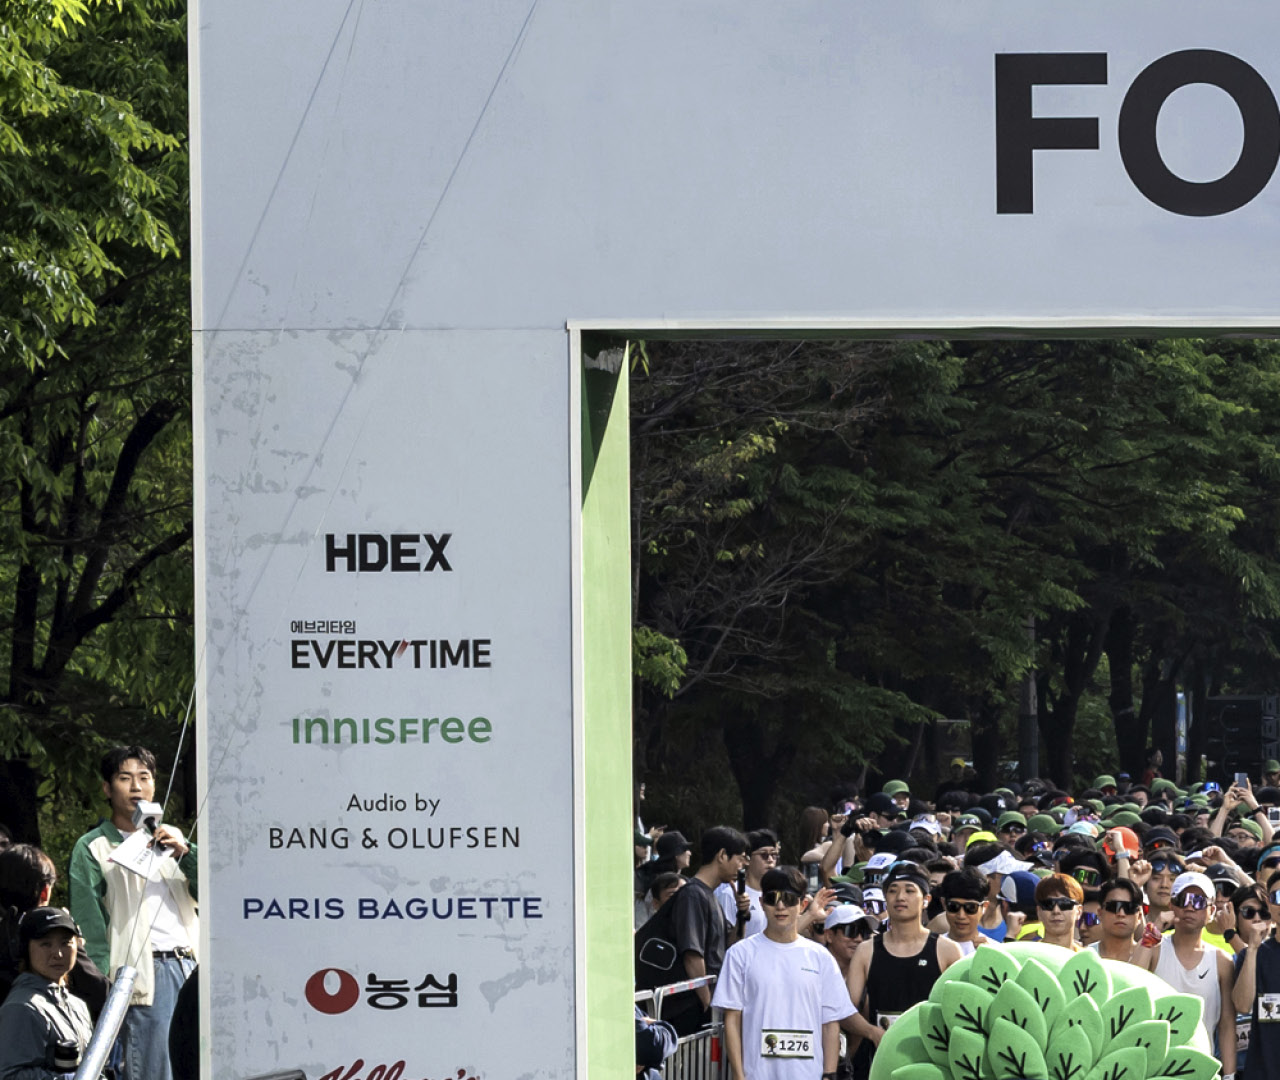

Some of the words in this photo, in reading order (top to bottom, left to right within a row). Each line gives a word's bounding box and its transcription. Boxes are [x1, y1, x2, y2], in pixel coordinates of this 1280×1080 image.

[325, 533, 453, 572] HDEX
[290, 620, 356, 634] 에브리타임
[347, 793, 406, 812] Audio
[415, 793, 440, 816] by
[269, 827, 349, 850] BANG
[361, 827, 378, 849] &
[387, 827, 521, 849] OLUFSEN
[243, 898, 344, 919] PARIS
[358, 897, 543, 919] BAGUETTE
[365, 973, 458, 1010] 농심
[779, 1040, 809, 1052] 1276
